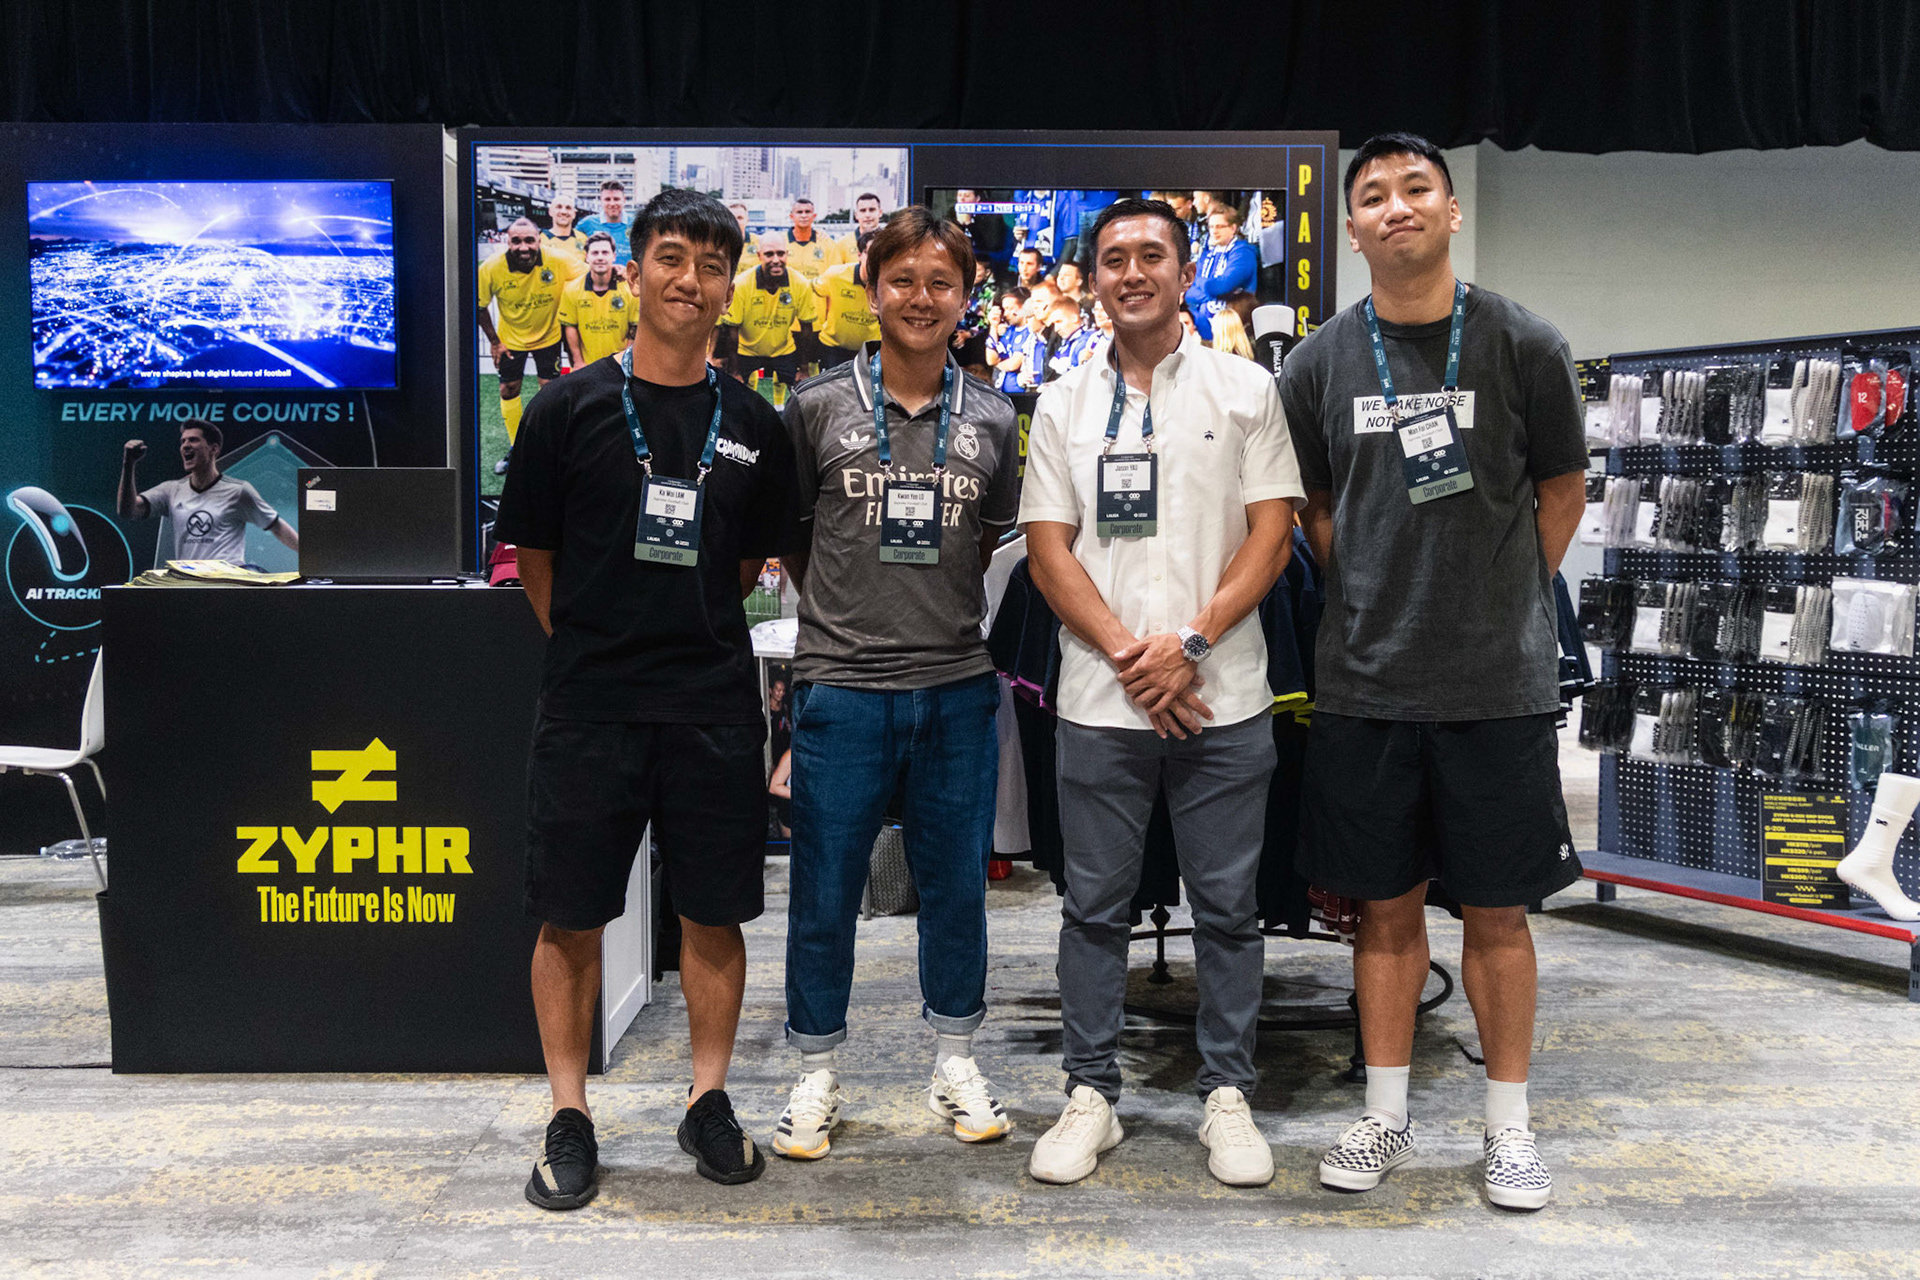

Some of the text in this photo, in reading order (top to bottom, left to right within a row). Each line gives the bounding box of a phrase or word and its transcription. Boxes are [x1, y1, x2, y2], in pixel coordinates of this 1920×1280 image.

[1273, 346, 1281, 371] ZYPHR
[140, 369, 292, 379] we're shaping the digital future of football
[1361, 400, 1381, 412] WE
[1424, 395, 1466, 409] NOSE
[1857, 392, 1868, 403] 12
[61, 402, 355, 422] EVERY MOVE COUNTS !
[1366, 416, 1391, 428] NOT
[1426, 420, 1439, 430] CHAN
[675, 491, 685, 499] LAM
[1423, 480, 1458, 498] Corporate
[1110, 523, 1143, 535] Corporate
[649, 547, 684, 562] Corporate
[893, 549, 926, 561] Corporate
[25, 588, 101, 600] AI TRACK
[236, 826, 474, 873] ZYPHR
[257, 886, 456, 923] The Future Is Now
